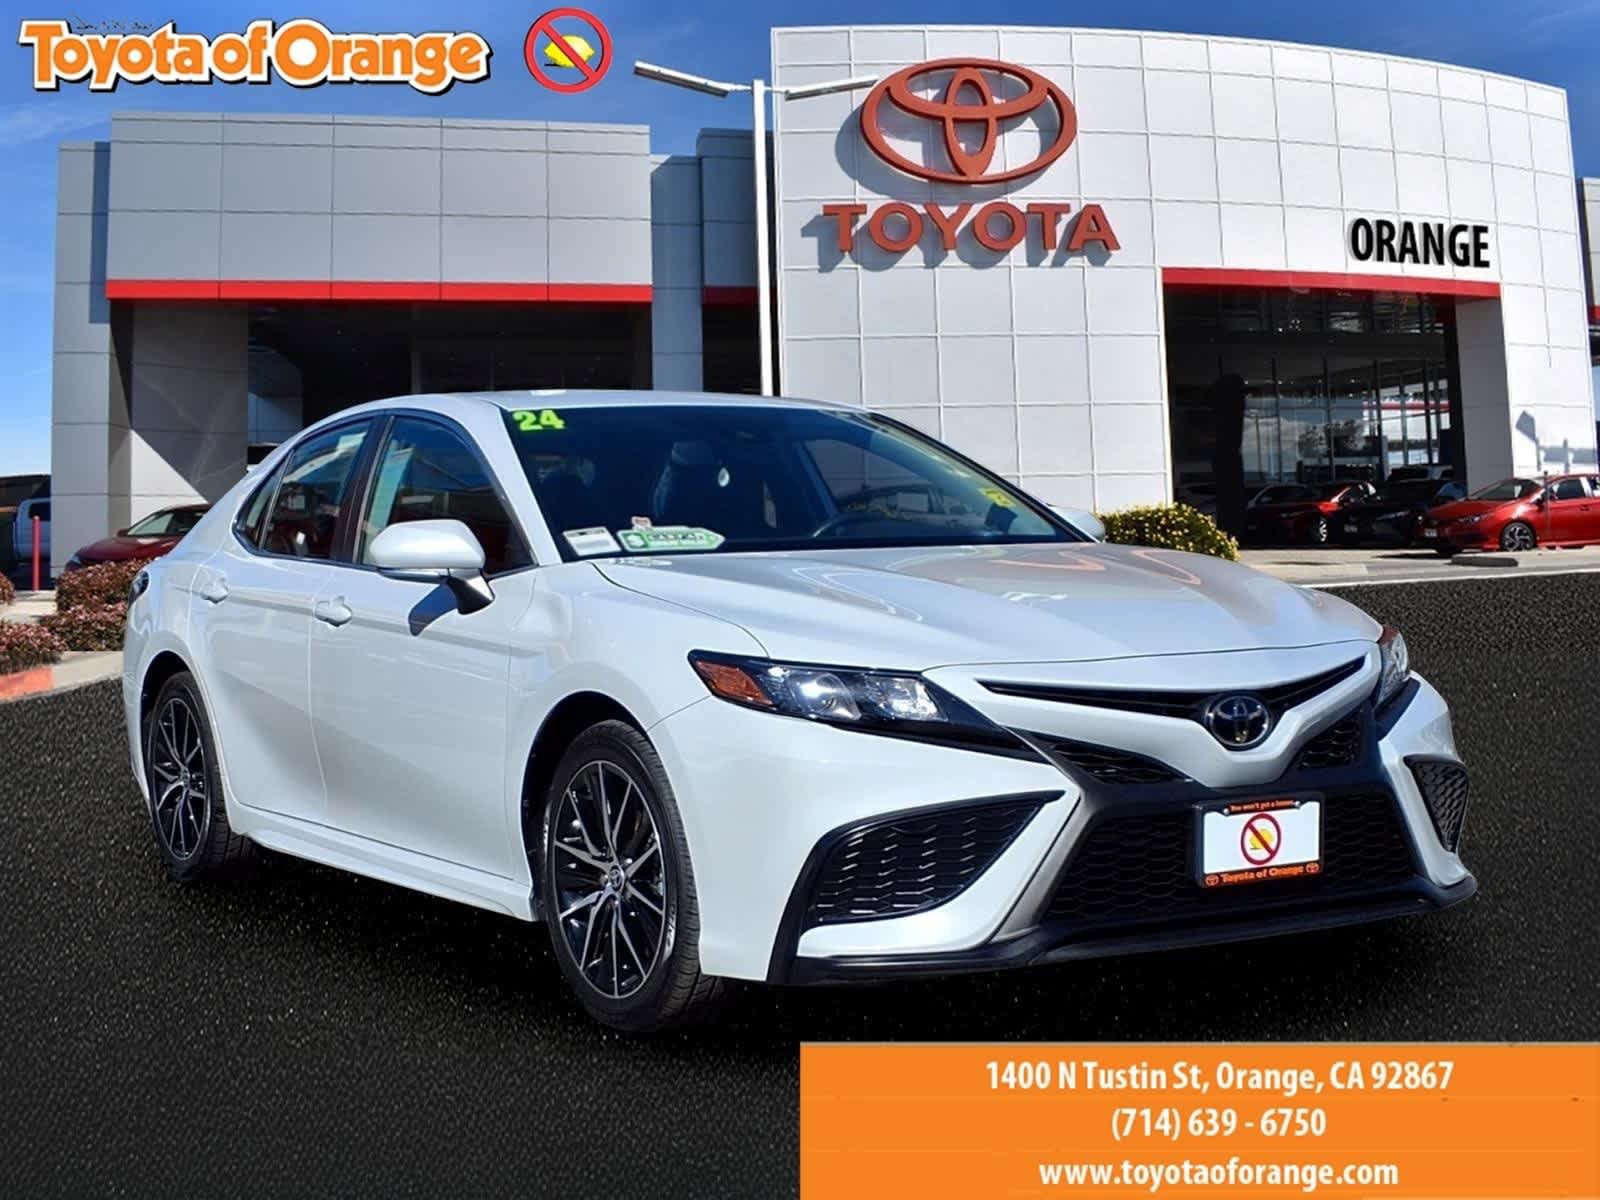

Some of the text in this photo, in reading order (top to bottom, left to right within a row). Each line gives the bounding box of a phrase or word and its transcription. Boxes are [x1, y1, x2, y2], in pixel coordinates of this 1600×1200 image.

[822, 202, 1120, 252] TOYOTA
[1350, 217, 1490, 268] ORANGE
[513, 409, 565, 431] 24
[1220, 865, 1304, 883] Toyota of Orange
